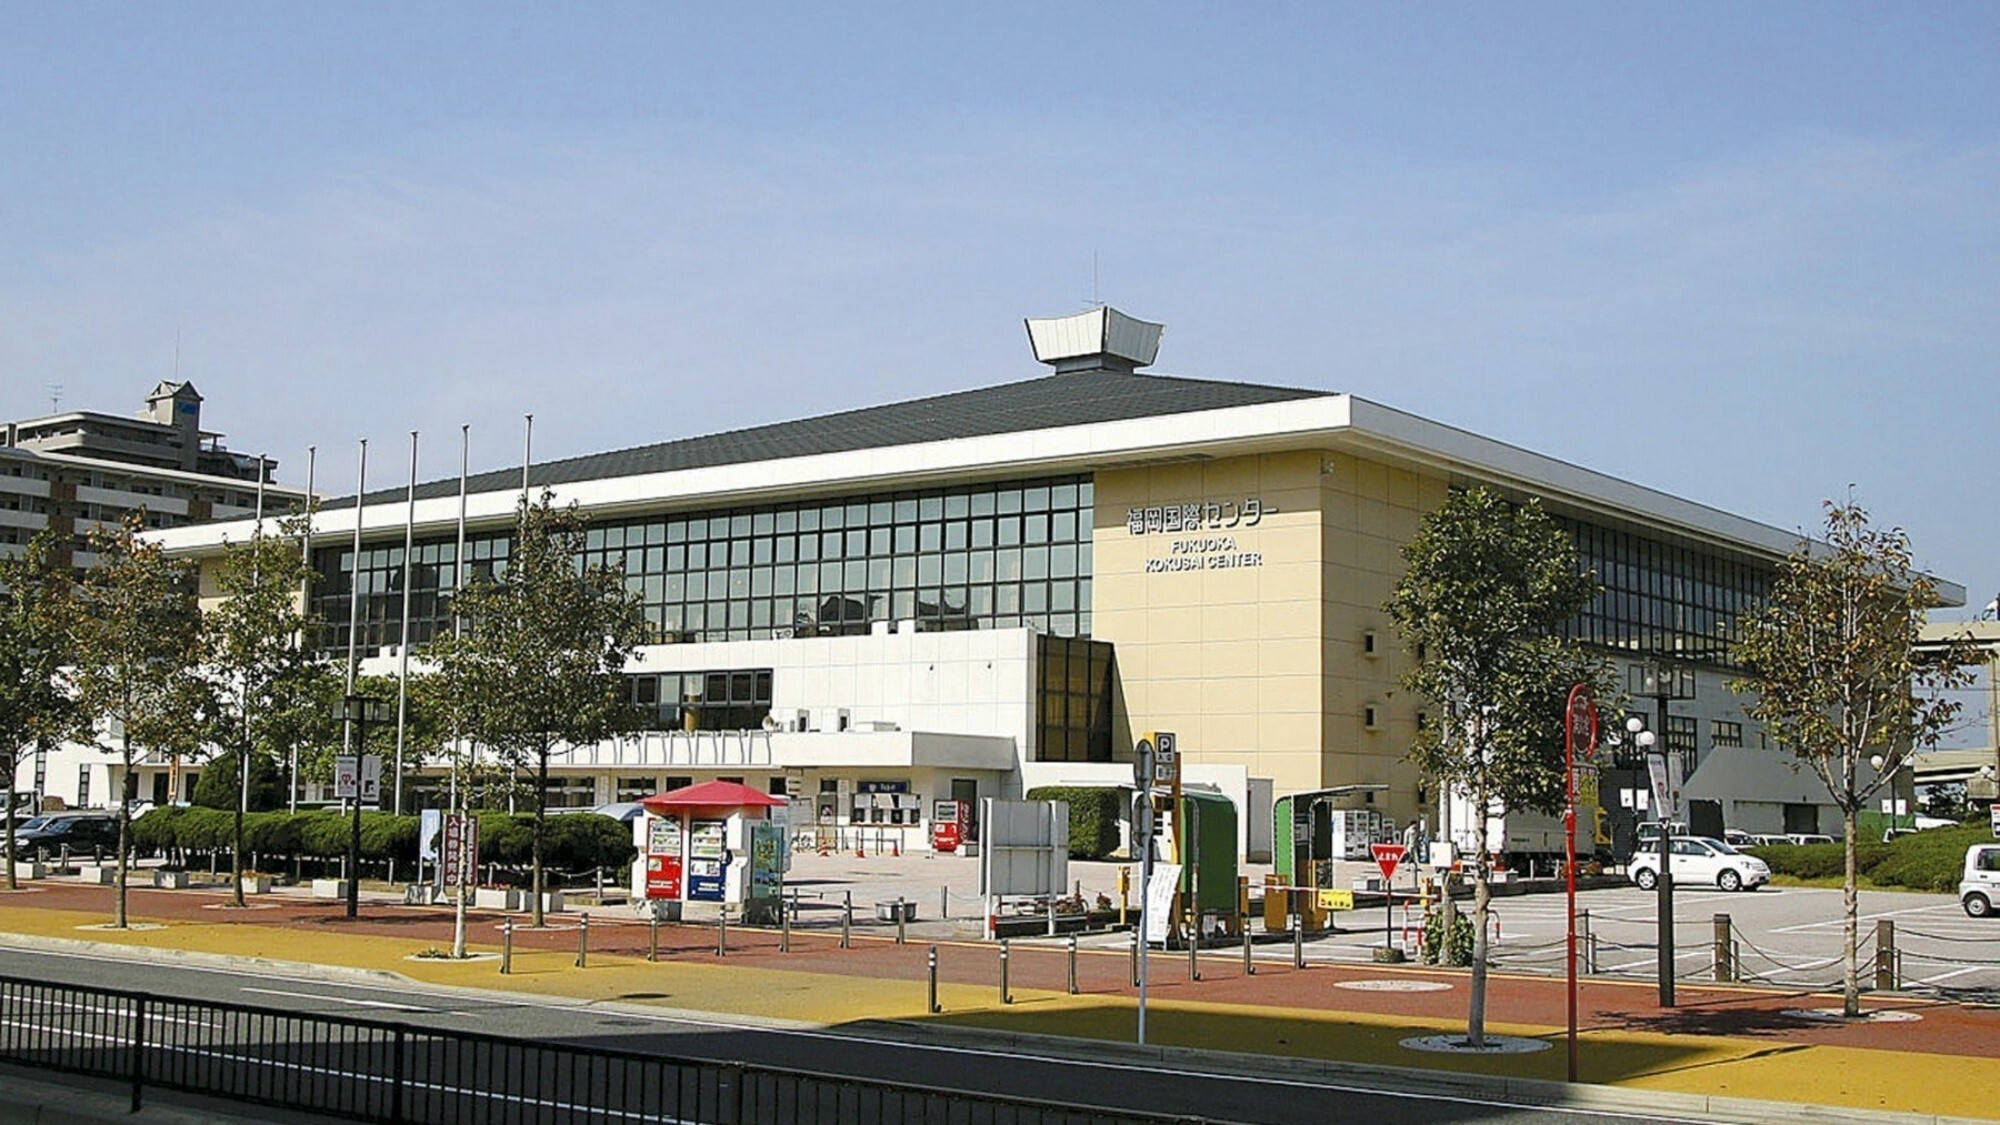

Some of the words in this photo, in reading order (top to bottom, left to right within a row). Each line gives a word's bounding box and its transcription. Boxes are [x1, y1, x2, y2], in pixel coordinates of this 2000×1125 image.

[1126, 498, 1279, 535] 福岡国際センター
[1171, 536, 1237, 554] FUKUOKA
[1145, 555, 1205, 573] KOKUSAI
[1207, 552, 1263, 569] CENTER
[1160, 738, 1170, 751] P
